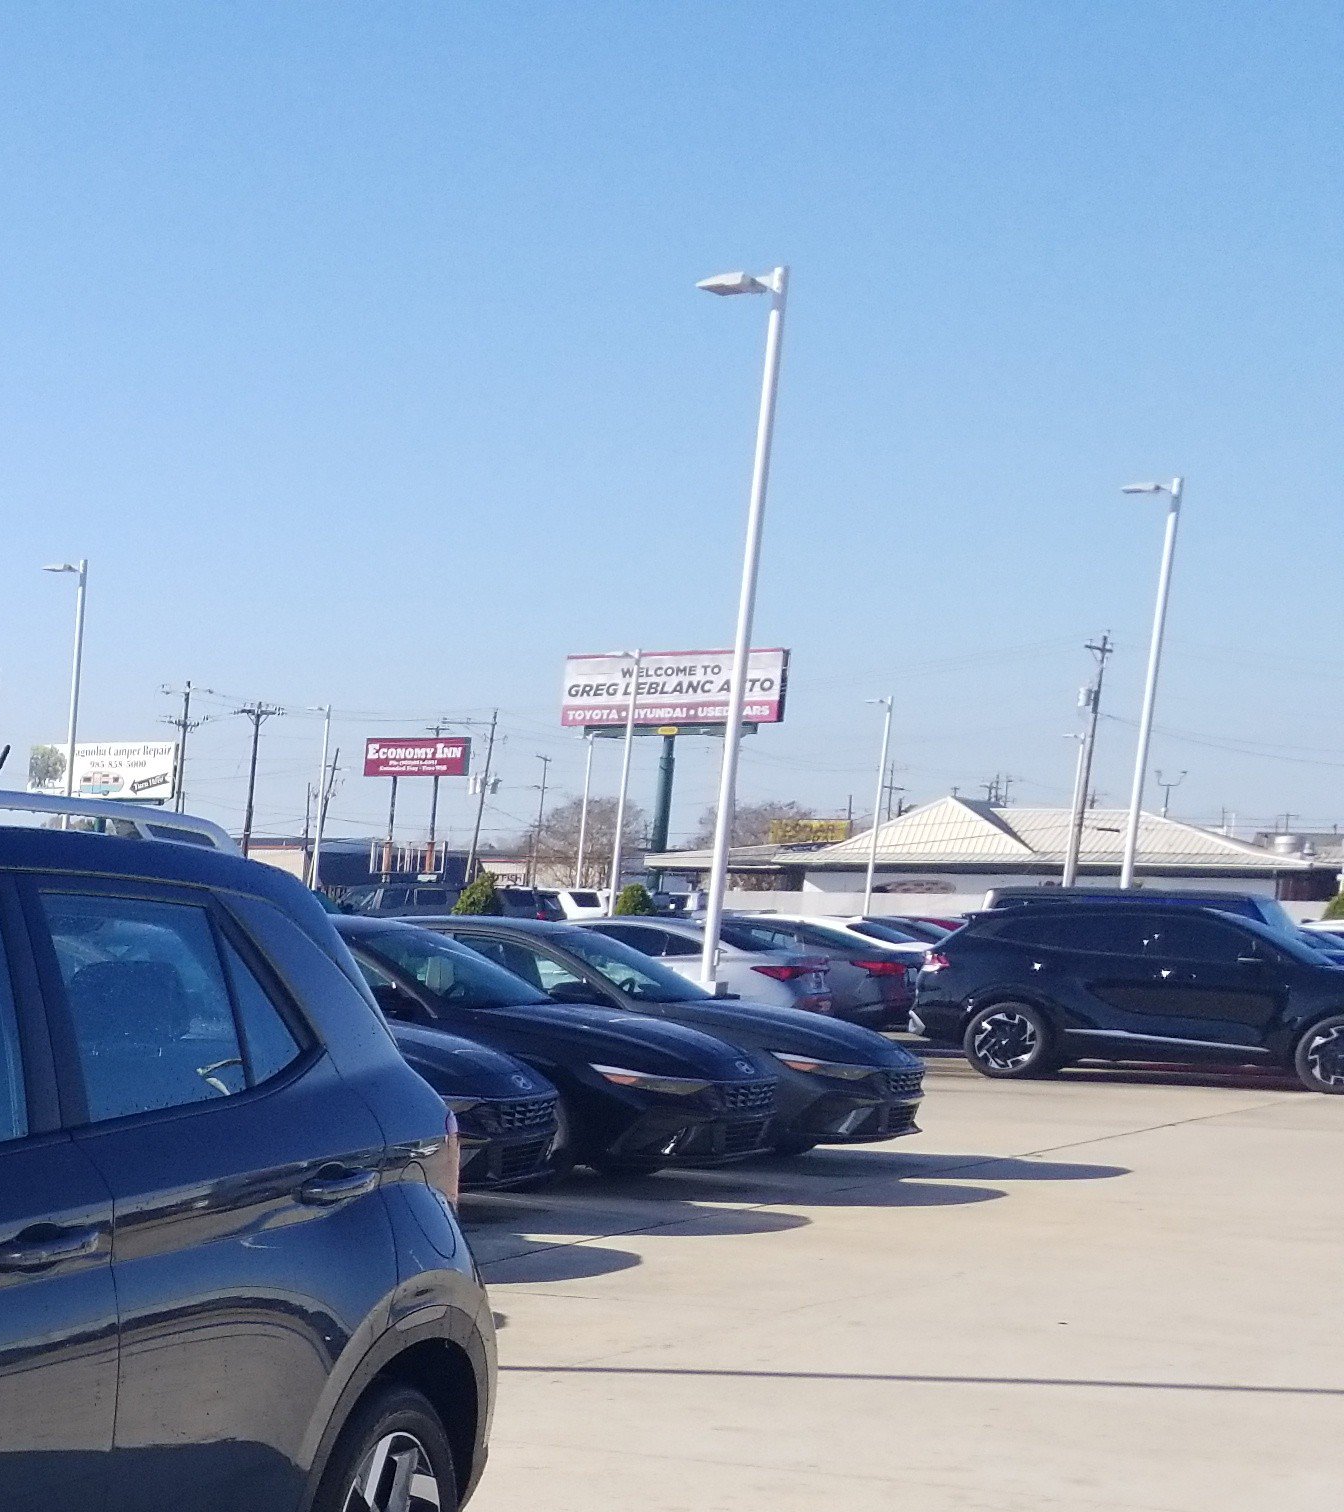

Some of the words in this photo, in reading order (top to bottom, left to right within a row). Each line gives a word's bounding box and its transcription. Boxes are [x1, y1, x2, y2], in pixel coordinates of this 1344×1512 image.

[621, 664, 697, 678] WELCOME
[702, 664, 722, 676] TO
[567, 682, 619, 697] GREG
[622, 679, 714, 696] LEBLANC
[716, 677, 775, 694] ATO
[567, 709, 619, 720] TOYOTA
[742, 705, 770, 716] ARS
[75, 745, 106, 757] agnolia
[367, 743, 434, 759] ECONOMY
